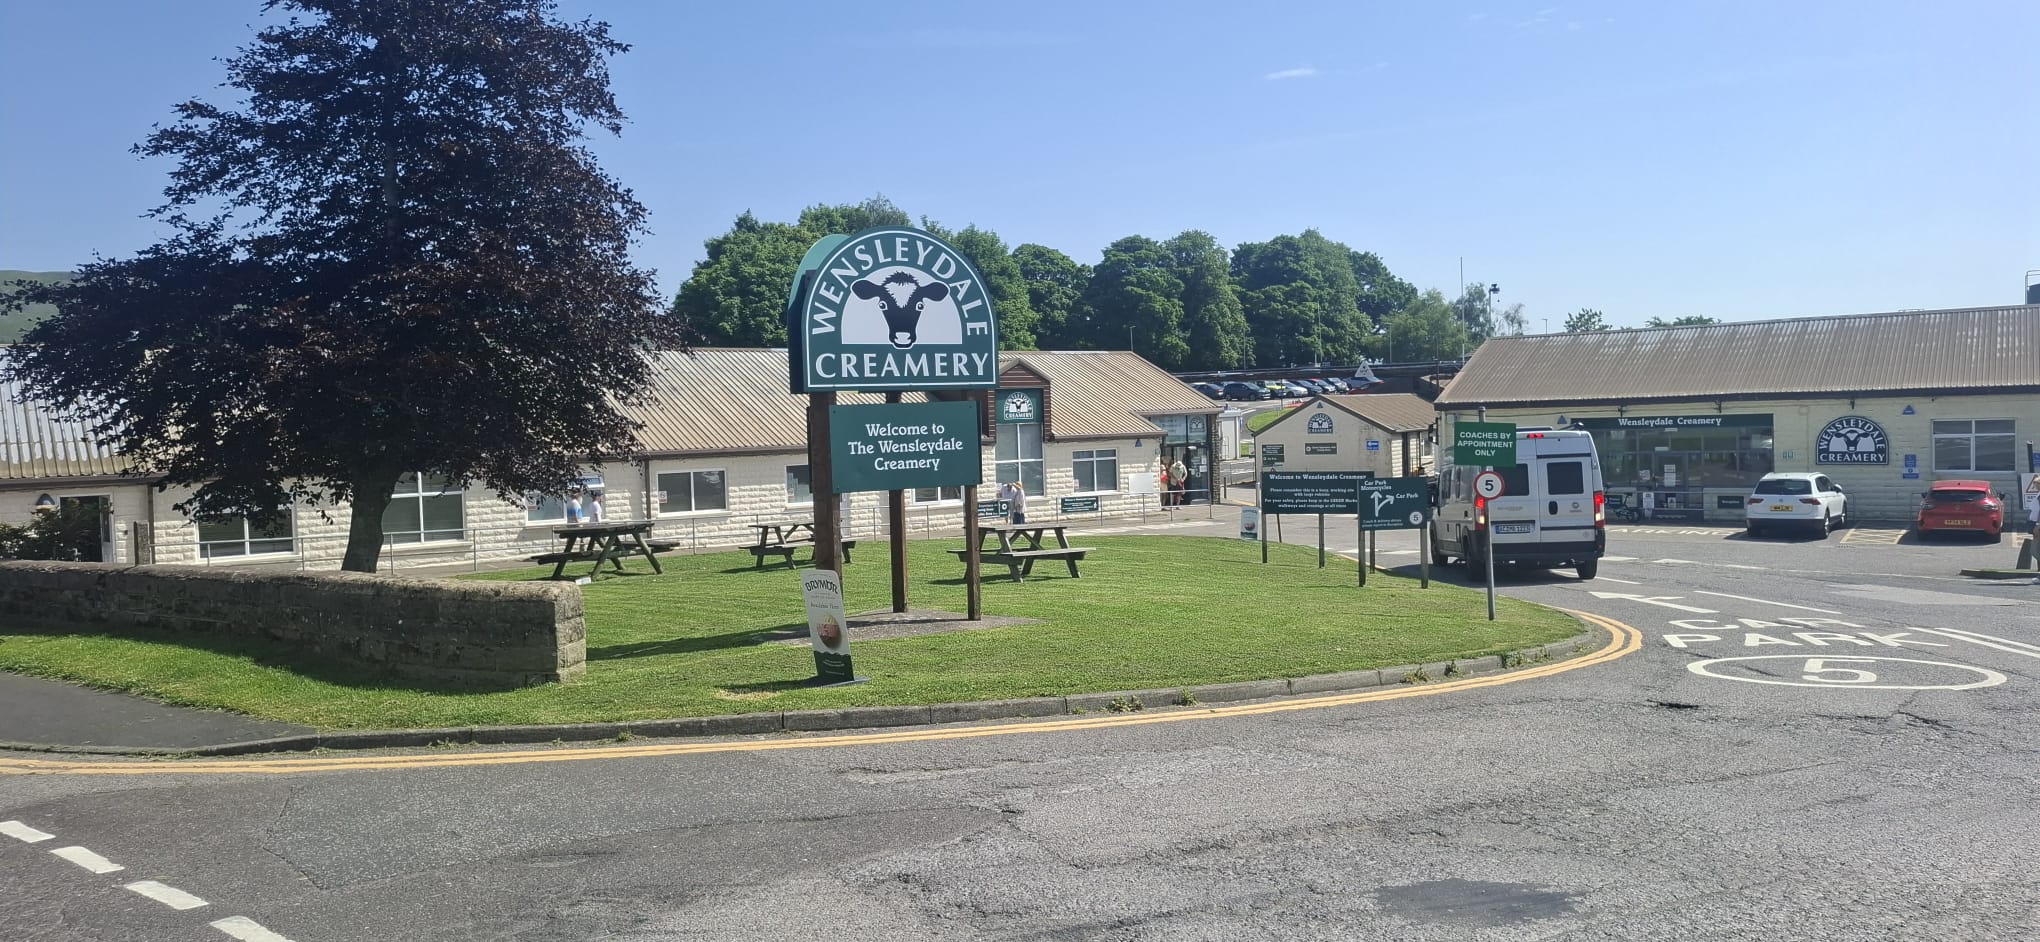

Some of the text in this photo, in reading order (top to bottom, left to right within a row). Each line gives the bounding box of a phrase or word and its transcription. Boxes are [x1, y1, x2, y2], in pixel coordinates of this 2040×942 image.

[812, 237, 988, 336] WENSLEYDALE
[815, 352, 988, 379] CREAMERY
[1618, 417, 1722, 428] Wensleydale Creamery
[865, 423, 945, 437] Welcome to
[1819, 418, 1886, 450] WENSLEYDALE
[848, 438, 963, 455] The Wensleydale
[1457, 440, 1513, 448] APPOINTMENT
[874, 457, 940, 471] Creamery
[1819, 453, 1886, 462] CREAMERY
[1485, 479, 1494, 491] 5
[1608, 528, 1739, 536] ARKING
[805, 579, 838, 594] BRYMOR
[1669, 617, 1866, 629] CAR
[1663, 632, 1949, 648] PARK
[1802, 658, 1877, 683] 5
